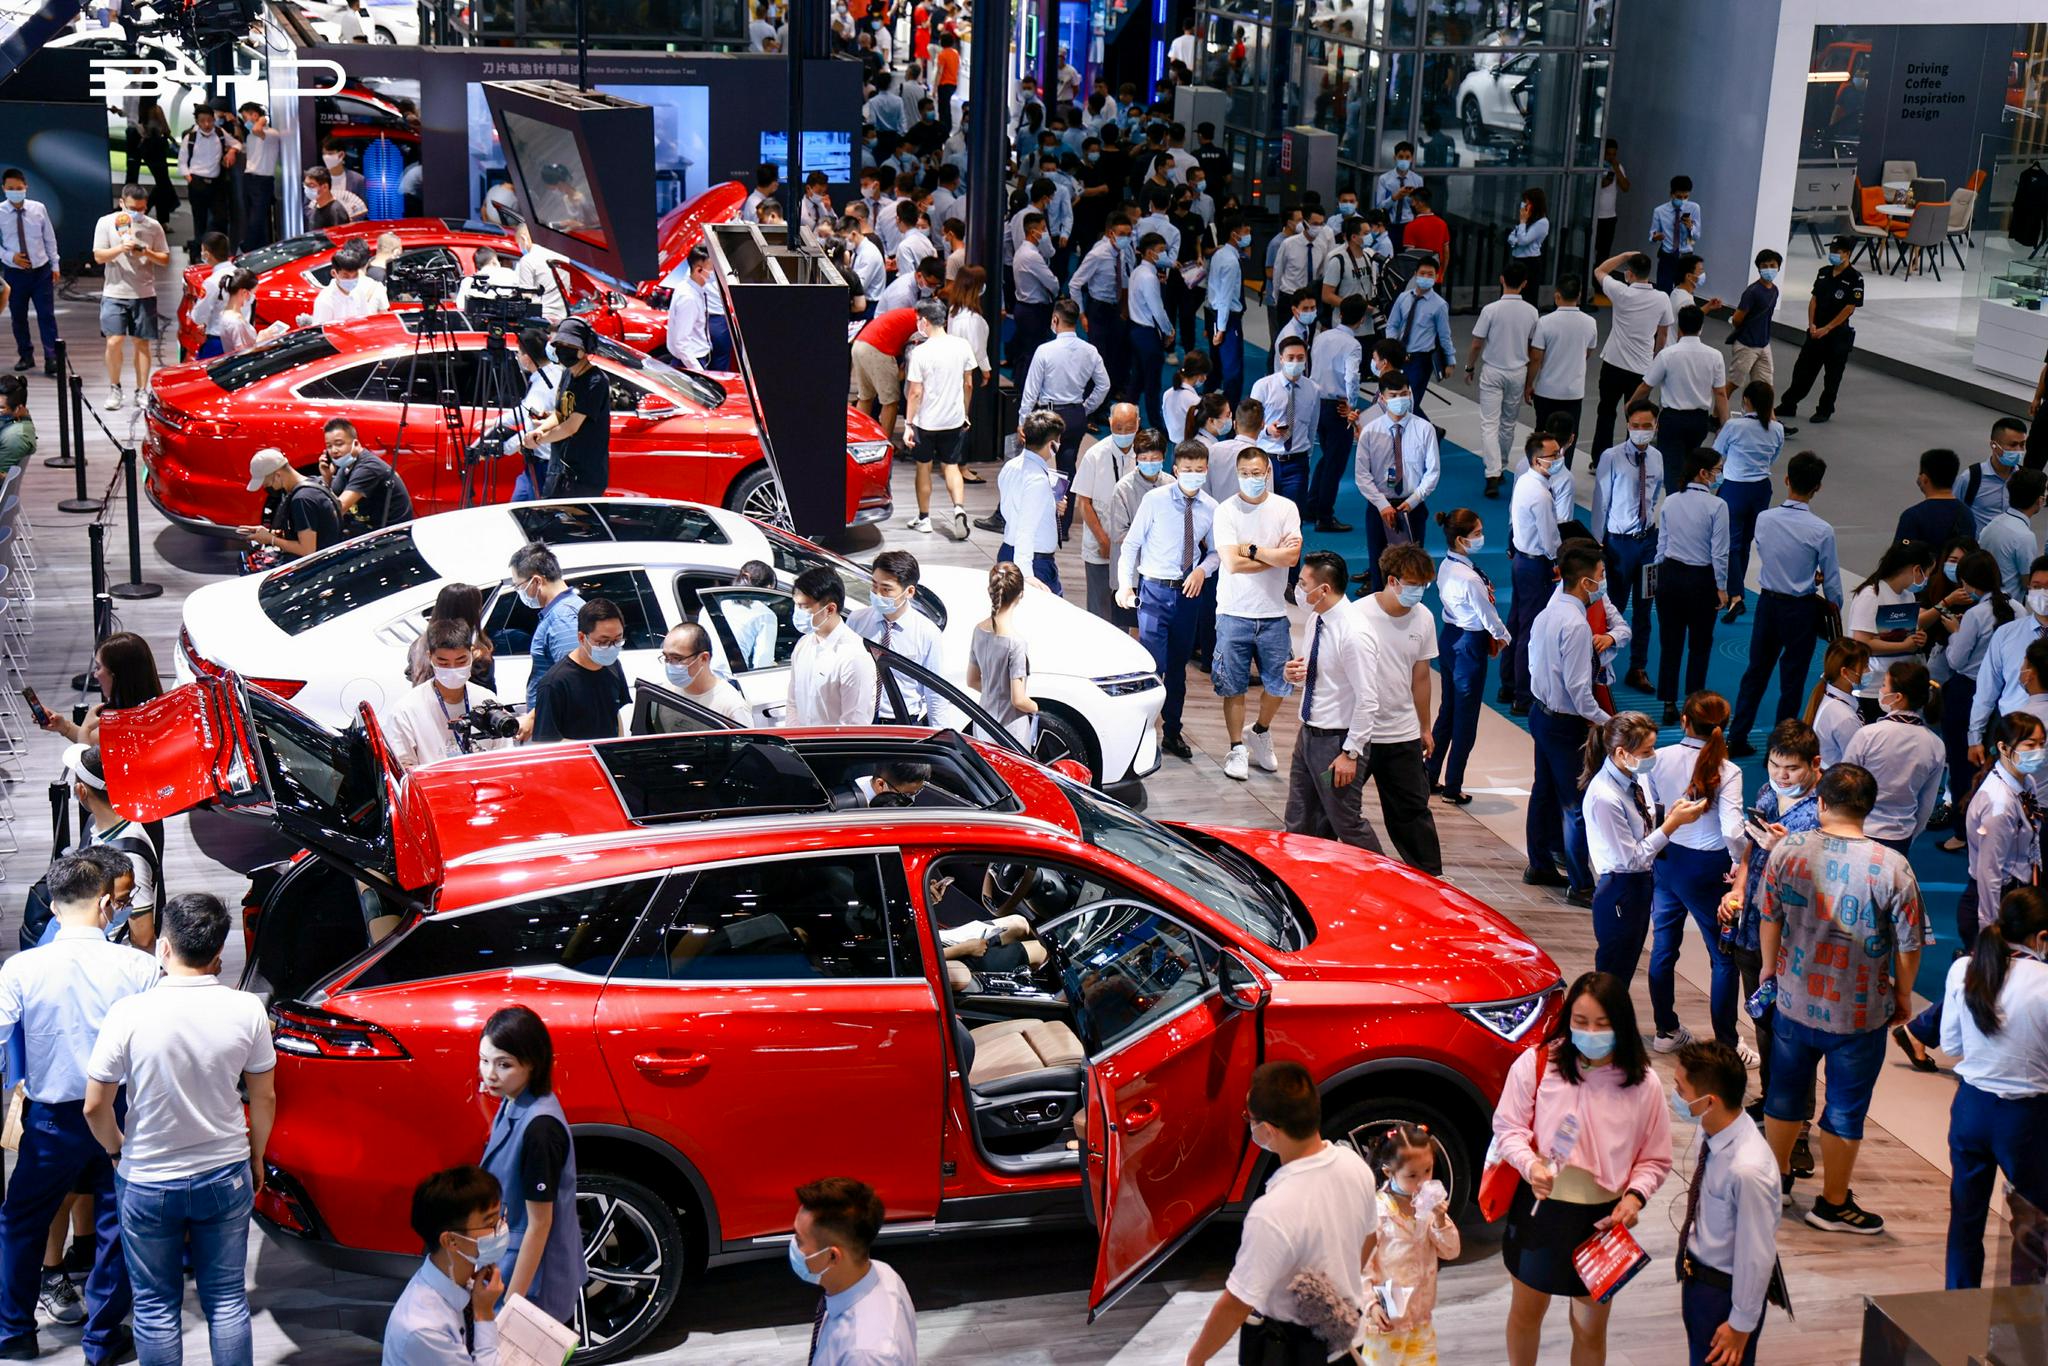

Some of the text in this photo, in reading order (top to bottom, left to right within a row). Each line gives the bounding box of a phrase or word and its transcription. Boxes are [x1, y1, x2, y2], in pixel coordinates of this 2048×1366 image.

[1907, 62, 1949, 77] Driving
[1905, 77, 1941, 89] Coffee
[1903, 92, 1965, 106] Inspiration
[1901, 107, 1940, 121] Design
[1826, 859, 1850, 884] 84
[1840, 895, 1877, 929] 84
